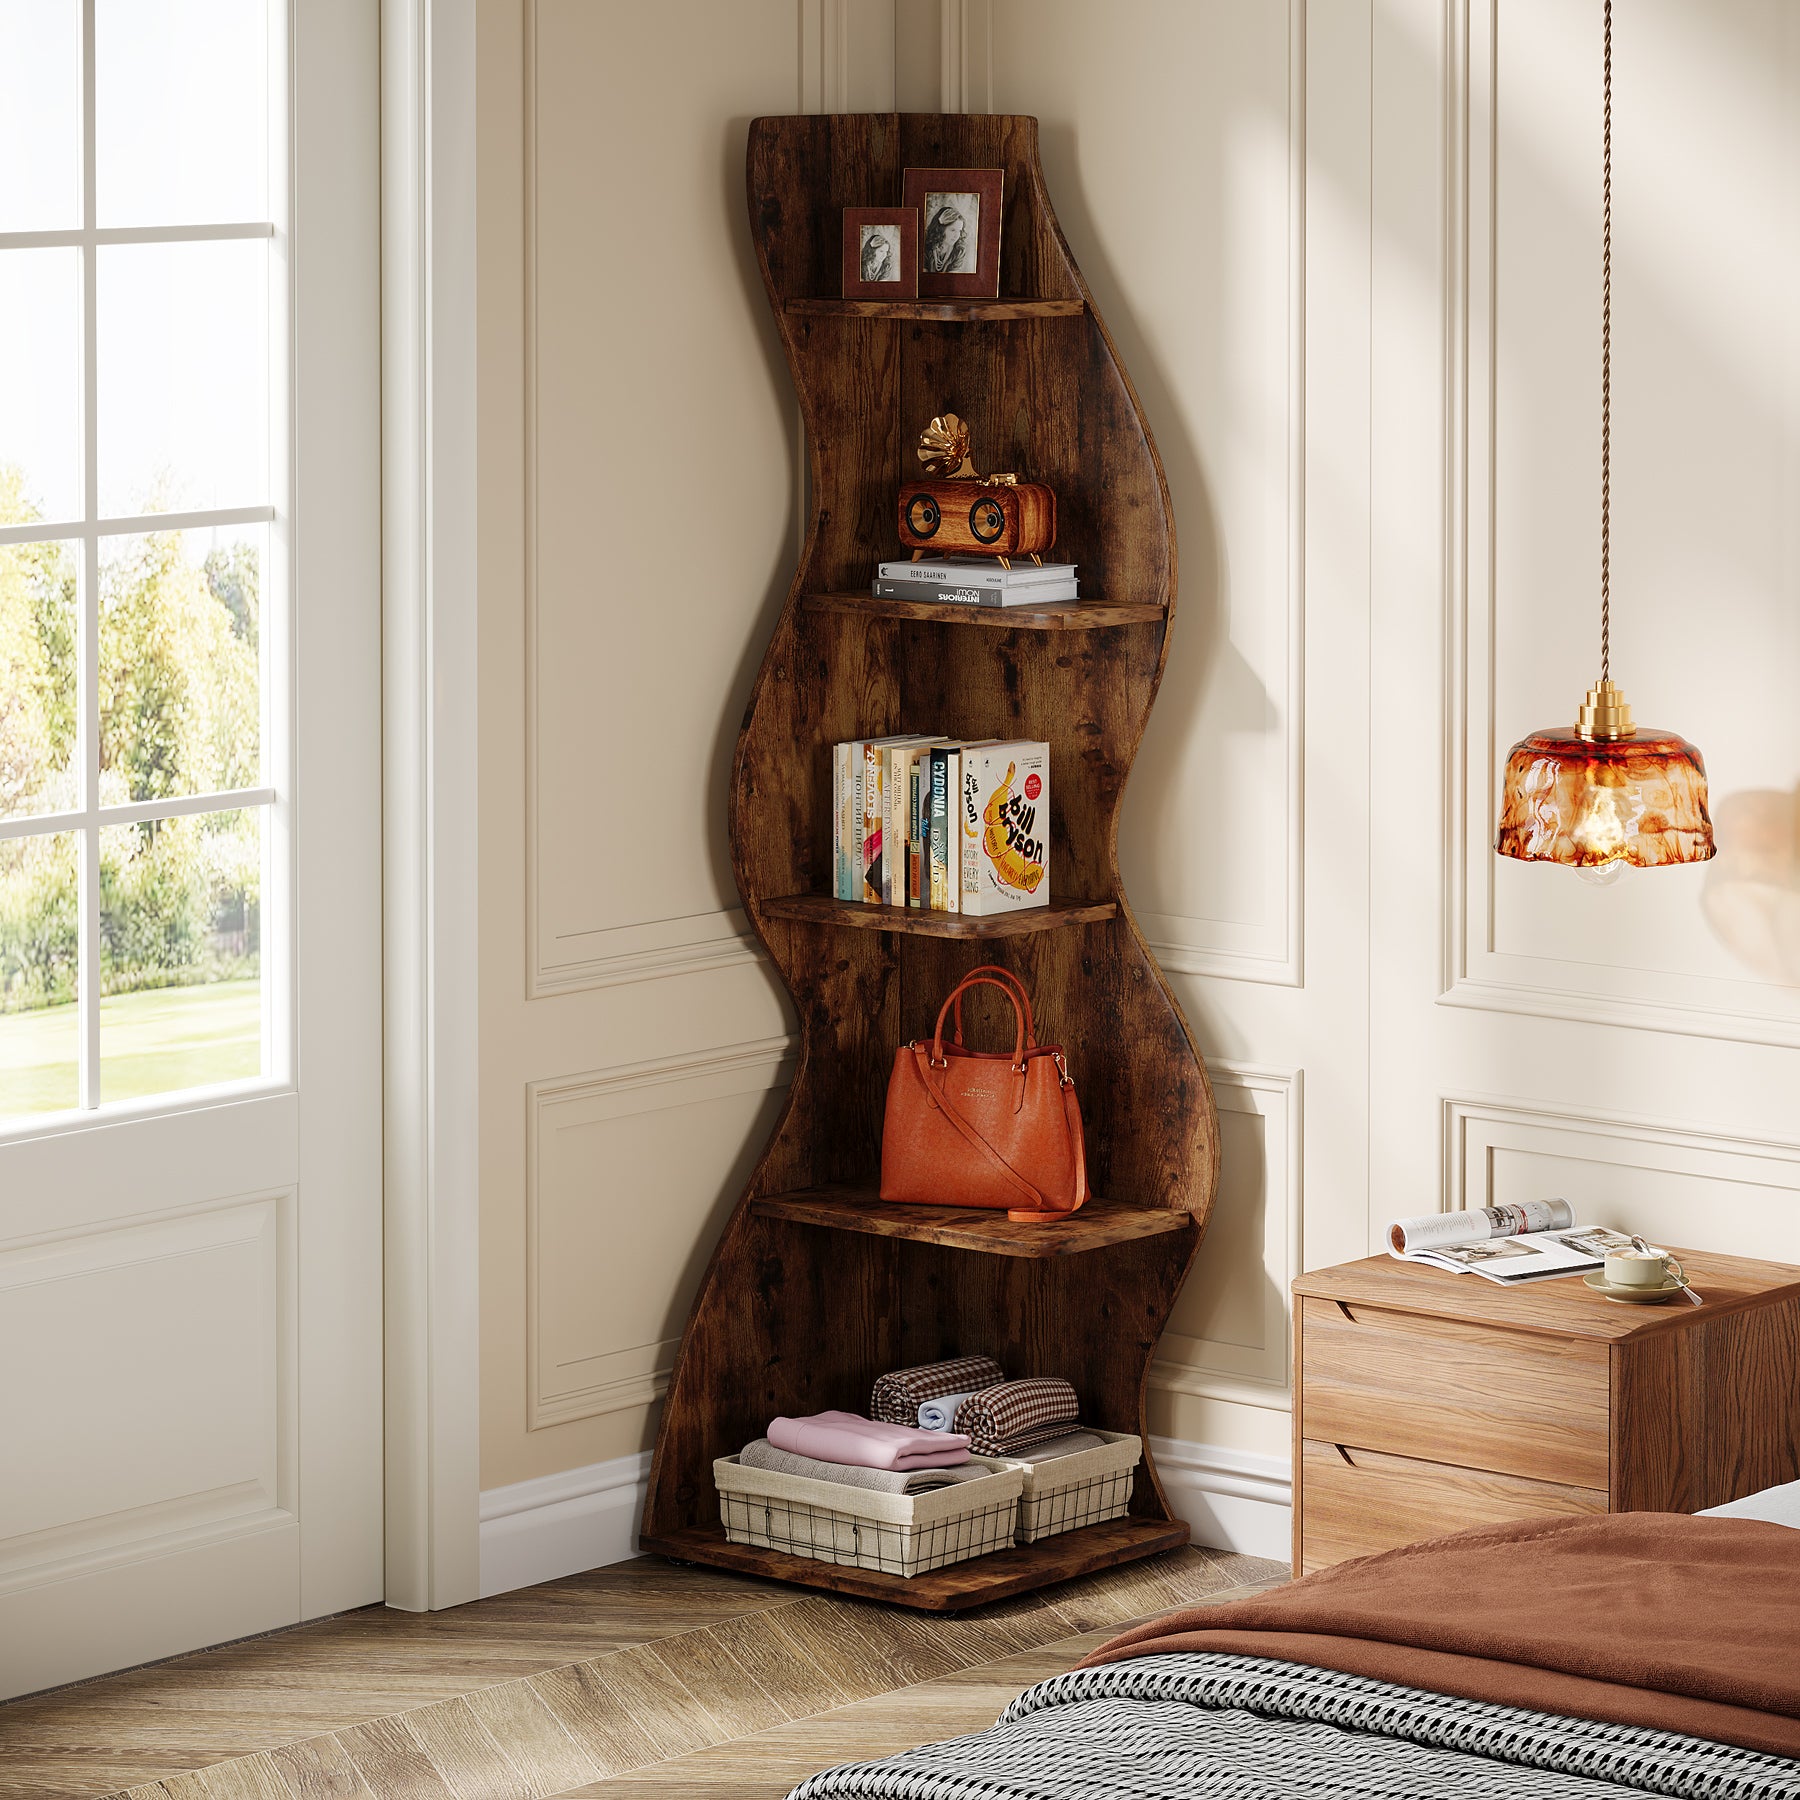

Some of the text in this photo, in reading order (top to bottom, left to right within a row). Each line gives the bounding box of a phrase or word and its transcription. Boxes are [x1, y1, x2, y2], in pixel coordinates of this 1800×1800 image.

[910, 570, 947, 580] EERO SAARINEN
[938, 593, 980, 603] INTERIORS
[855, 775, 863, 824] ПОНТИЙ
[866, 750, 875, 819] SLOVENKY
[933, 761, 946, 818] CYDONIA
[964, 772, 978, 823] bryson
[971, 778, 979, 794] bill
[998, 803, 1043, 863] bryson
[1009, 794, 1036, 835] bill
[963, 866, 979, 880] EVERY
